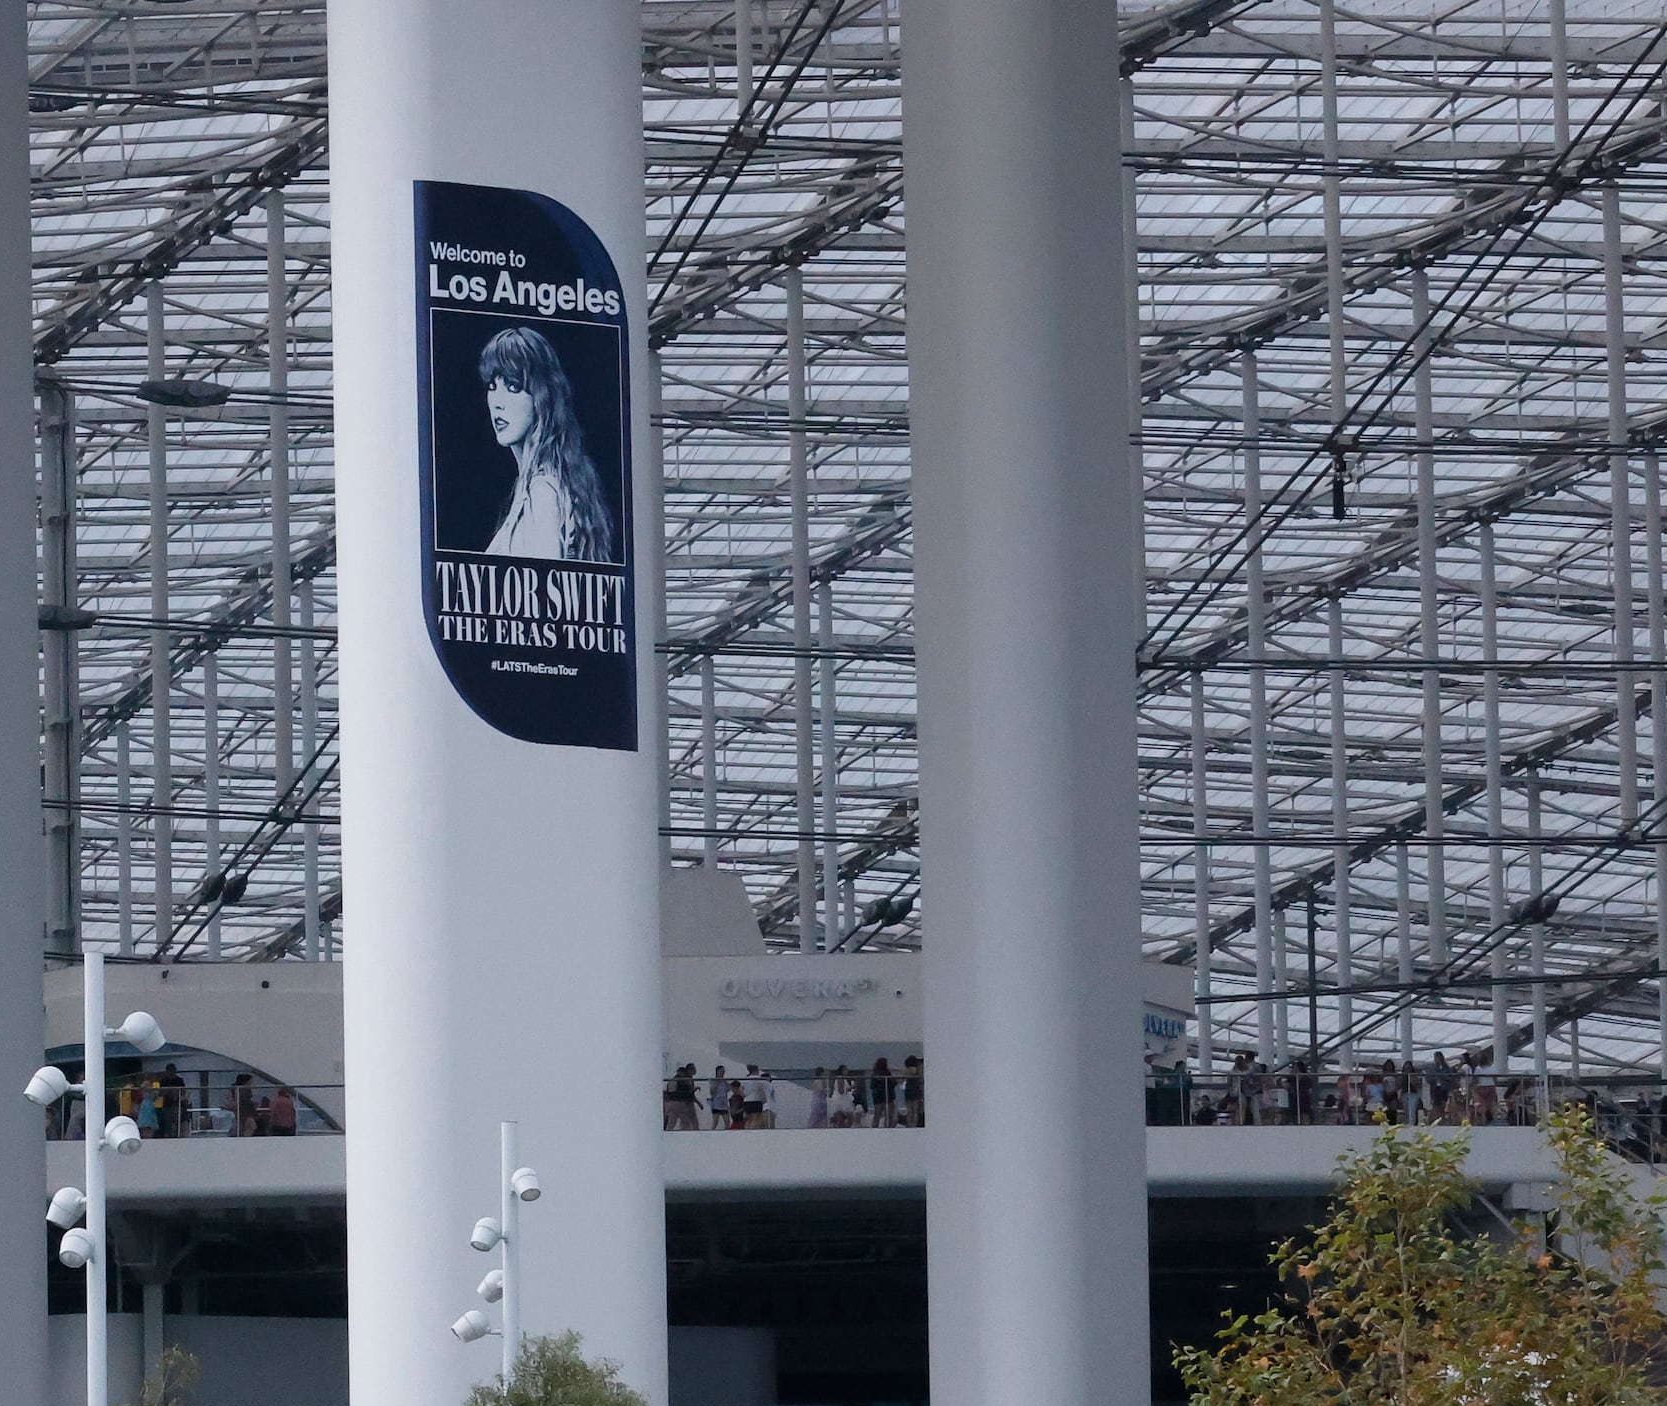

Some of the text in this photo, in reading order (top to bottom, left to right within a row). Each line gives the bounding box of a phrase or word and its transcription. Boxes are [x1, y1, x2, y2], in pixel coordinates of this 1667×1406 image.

[429, 241, 527, 268] Welcome to
[429, 263, 621, 316] Los Angeles
[435, 561, 626, 625] TAYLOR SWIFT
[438, 615, 627, 654] THE ERAS TOUR
[490, 659, 579, 677] #LATSTheErasTour
